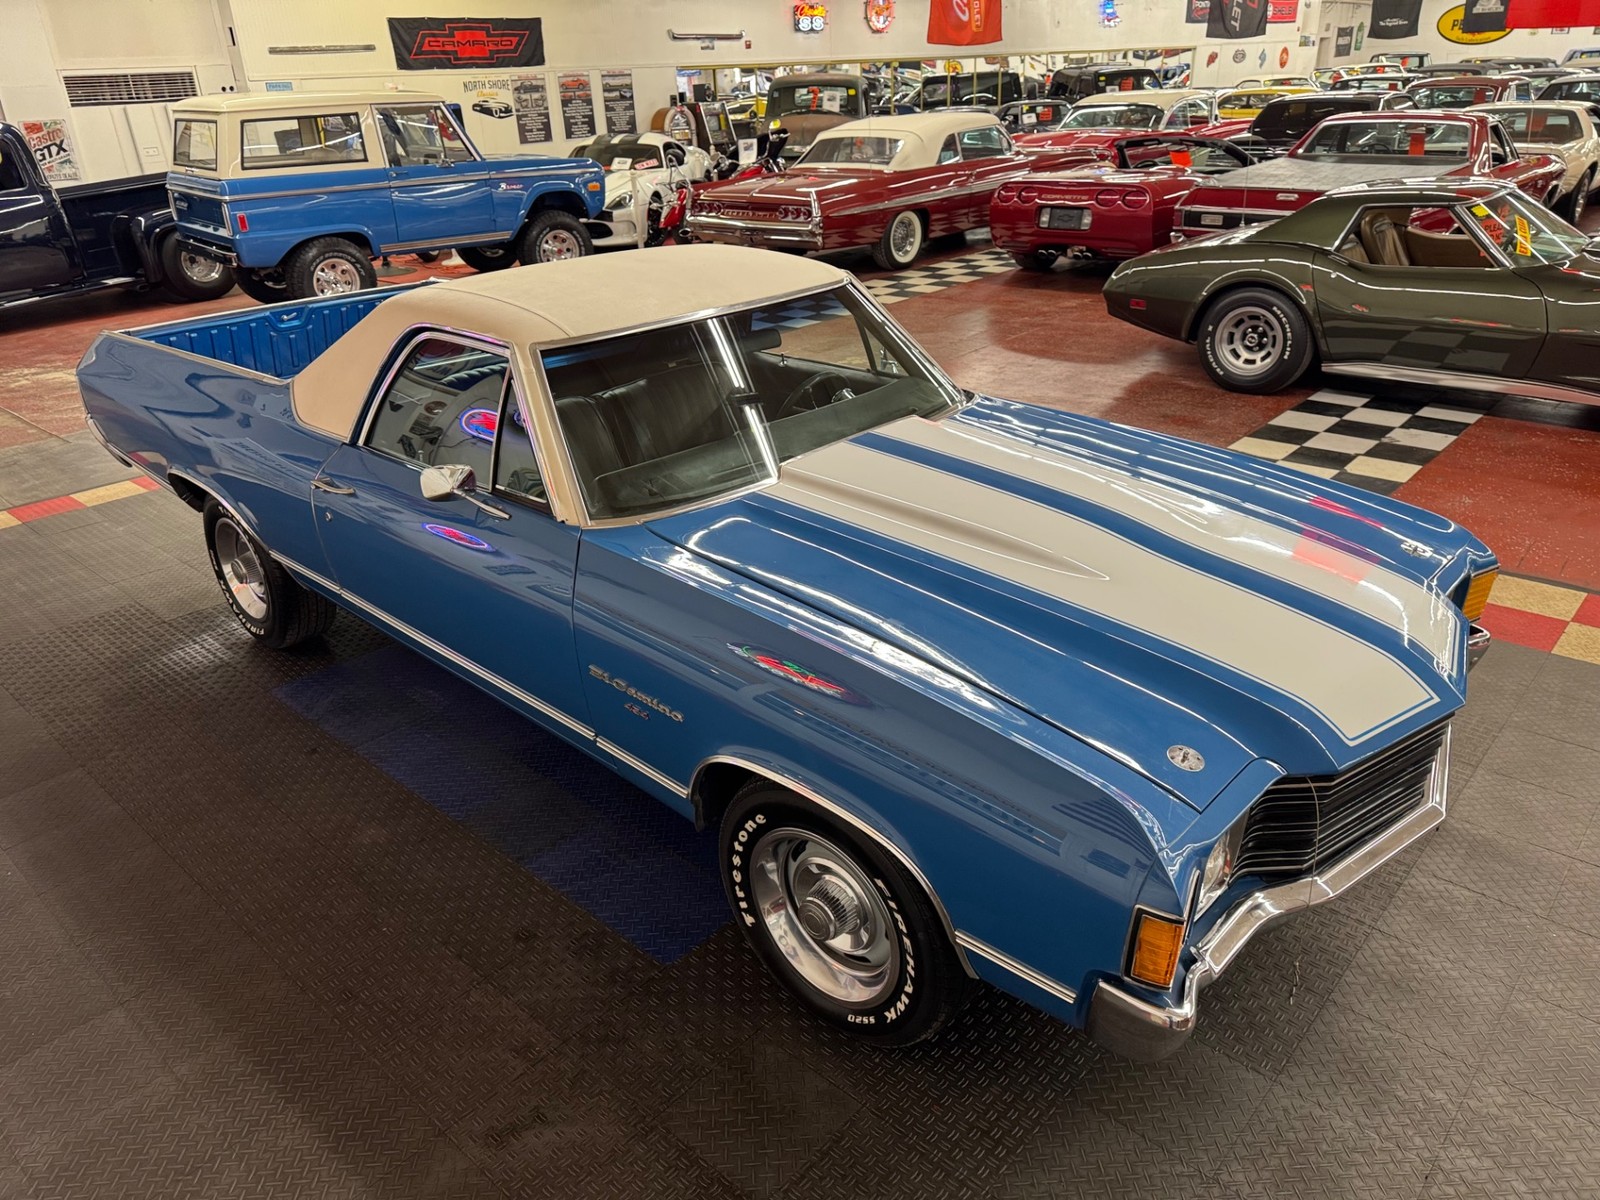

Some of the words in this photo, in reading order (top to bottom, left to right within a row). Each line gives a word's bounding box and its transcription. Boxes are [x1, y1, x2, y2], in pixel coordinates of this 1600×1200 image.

[798, 16, 824, 31] SS
[427, 38, 514, 49] CAMARO
[463, 80, 487, 93] NORTH
[488, 79, 511, 91] SHORE
[34, 139, 68, 163] GTX
[1041, 193, 1089, 201] CORVETTE
[1271, 305, 1294, 361] MICHELIN
[1205, 336, 1225, 376] RADIAL
[612, 678, 685, 723] Camino
[727, 812, 768, 929] Firestone
[872, 877, 917, 1024] FIREHAWK
